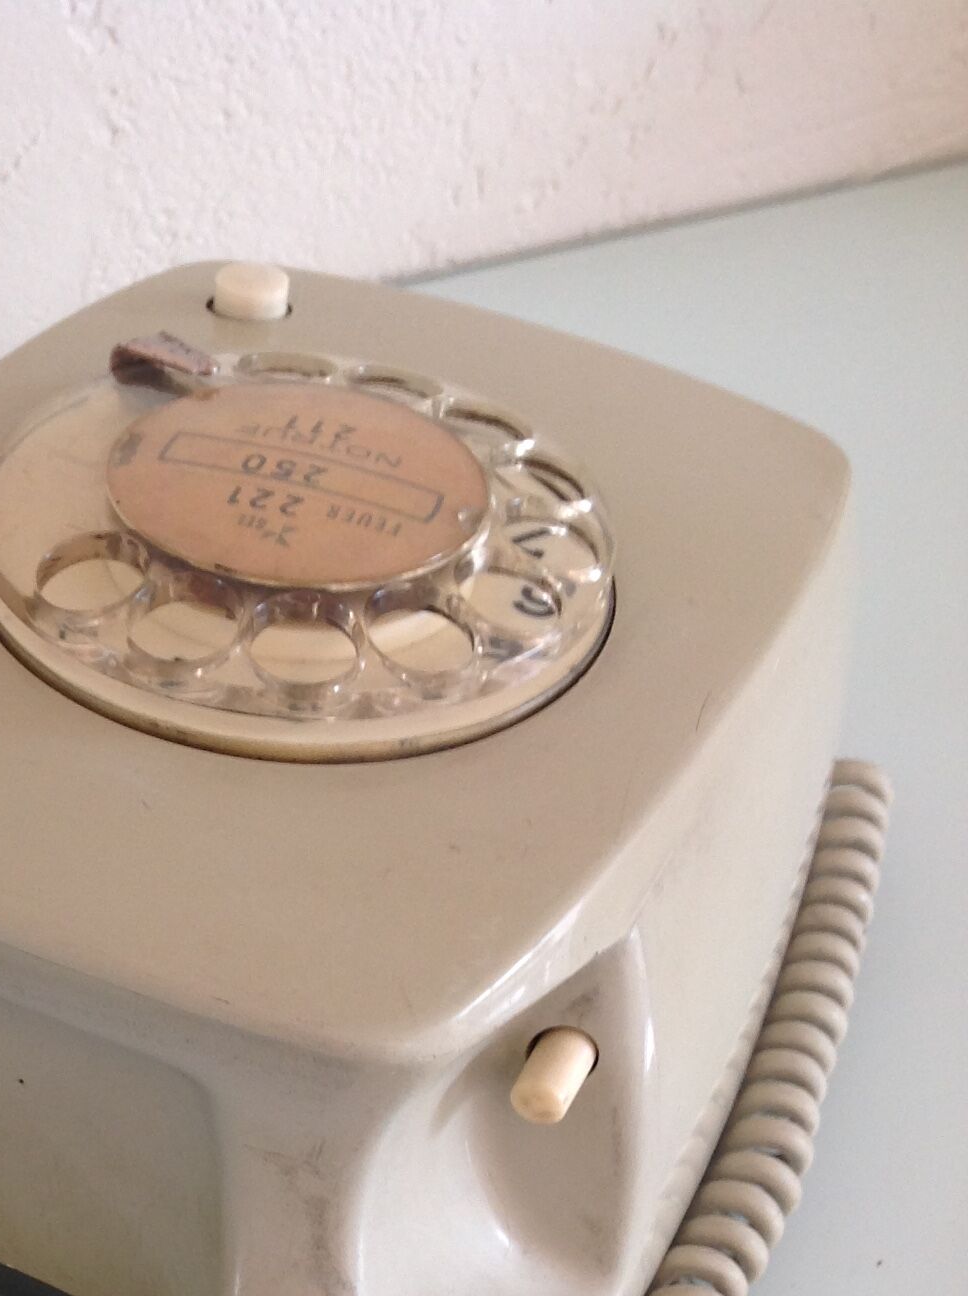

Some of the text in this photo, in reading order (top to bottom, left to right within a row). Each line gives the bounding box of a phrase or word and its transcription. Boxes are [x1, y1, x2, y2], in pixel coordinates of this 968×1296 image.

[240, 453, 328, 485] 250
[227, 486, 304, 517] 221
[326, 504, 403, 536] FEUER
